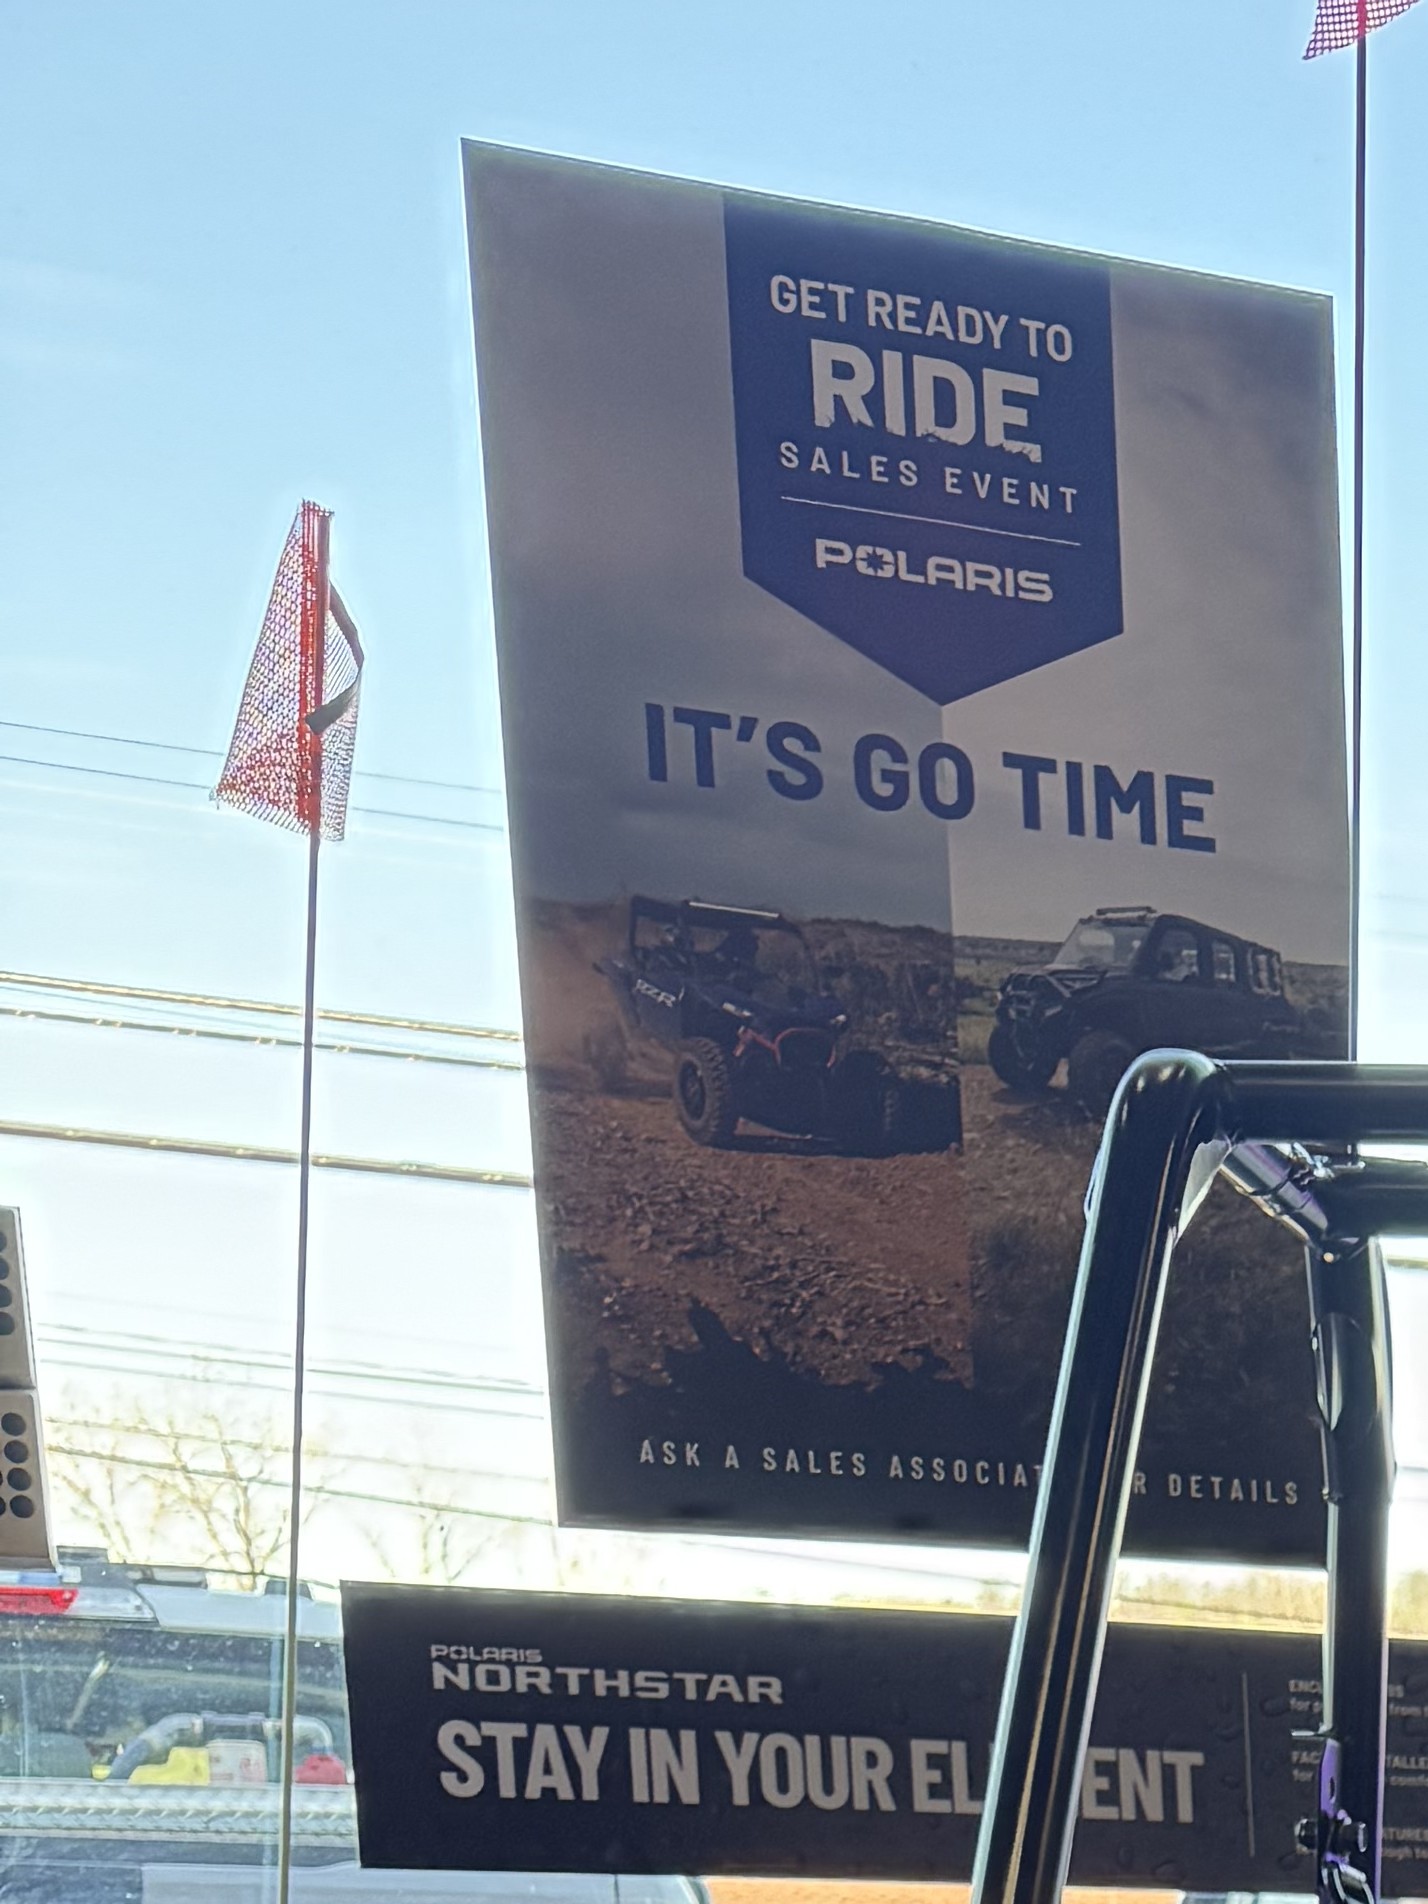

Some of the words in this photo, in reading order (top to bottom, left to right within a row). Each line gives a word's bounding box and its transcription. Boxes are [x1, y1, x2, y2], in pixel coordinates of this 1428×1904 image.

[769, 274, 855, 324] GET
[867, 289, 1009, 350] READY
[1019, 318, 1073, 363] TO
[810, 338, 1043, 463] RIDE
[779, 440, 919, 488] SALES
[944, 467, 1079, 514] EVENT
[814, 538, 1054, 603] POLARIS
[644, 701, 824, 801] IT'S
[853, 733, 976, 821] GO
[1001, 751, 1218, 853] TIME
[639, 1438, 701, 1468] ASK
[723, 1444, 741, 1470] A
[761, 1446, 869, 1479] SALES
[888, 1454, 1045, 1488] ASSOCIAT
[1168, 1473, 1300, 1506] DETAILS
[429, 1643, 543, 1664] POLARIS
[431, 1661, 784, 1705] NORTHSTAR
[436, 1719, 610, 1801] STAY
[628, 1727, 700, 1805] IN
[714, 1731, 897, 1812] YOUR
[909, 1738, 1206, 1825] ELENT
